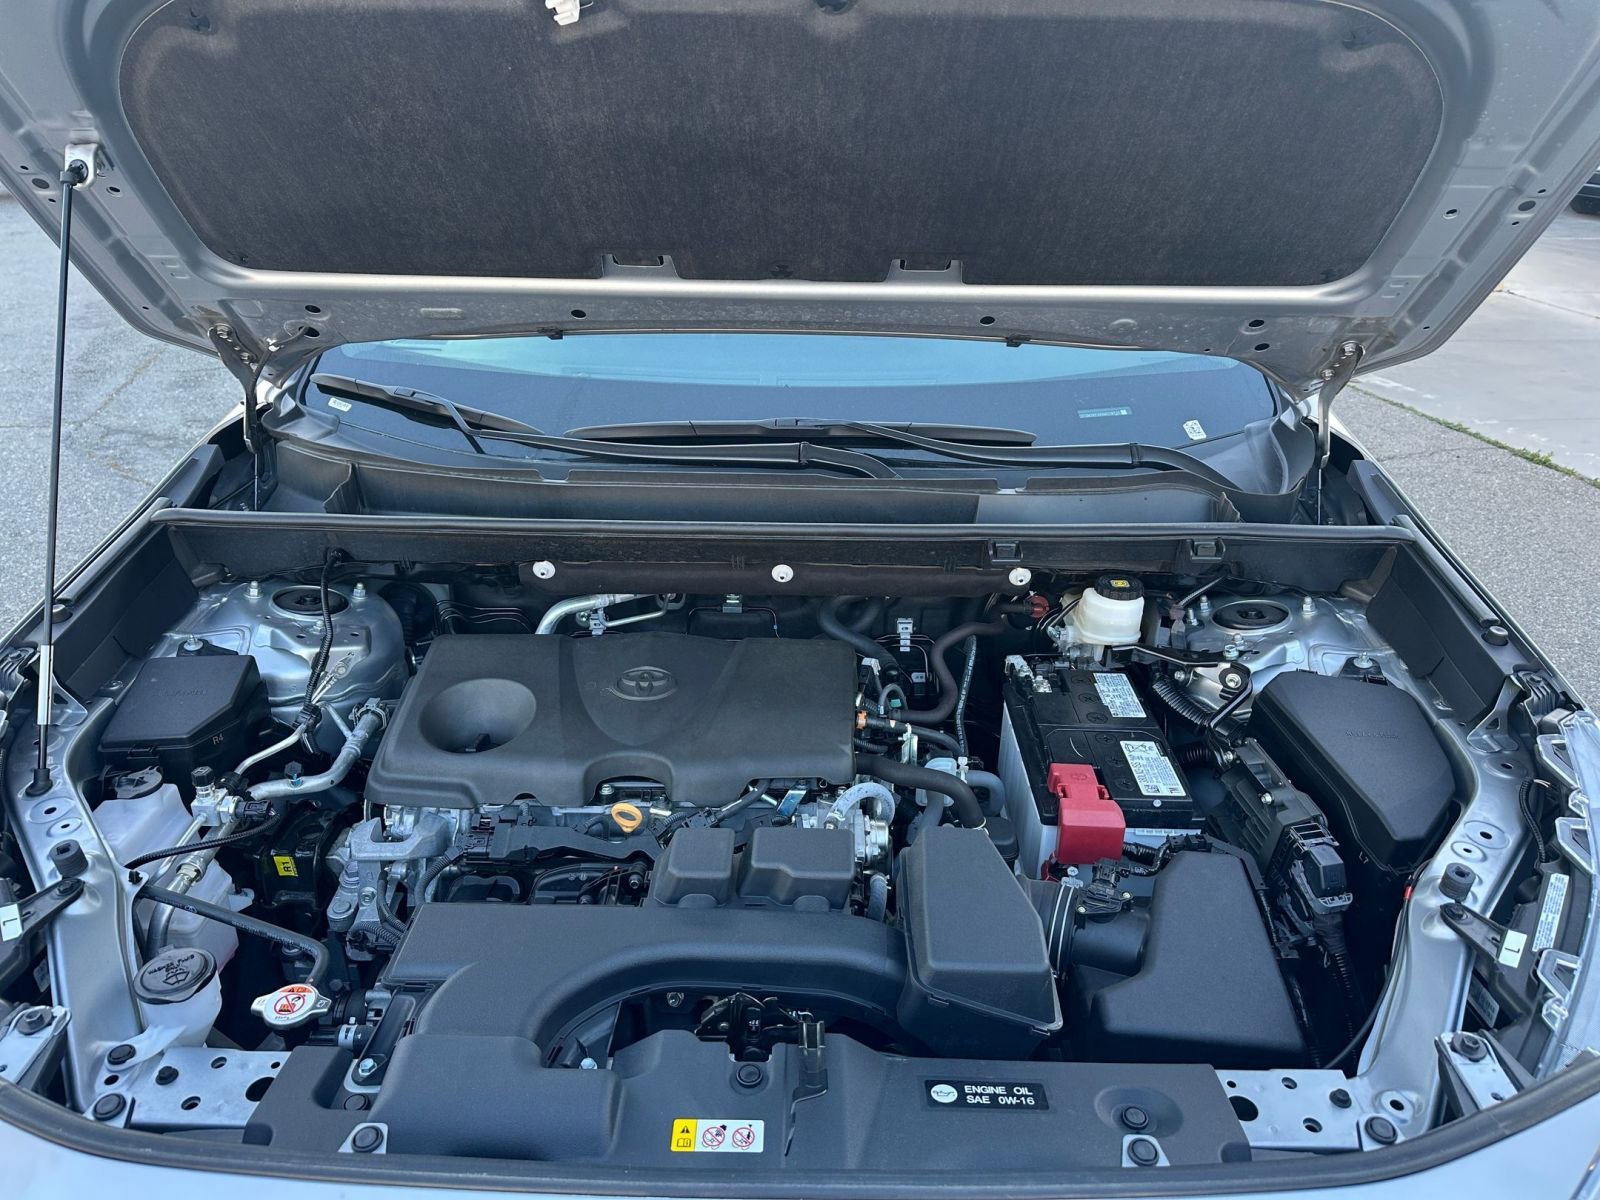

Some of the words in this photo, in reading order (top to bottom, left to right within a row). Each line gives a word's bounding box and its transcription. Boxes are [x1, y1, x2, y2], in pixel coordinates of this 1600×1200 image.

[964, 1085, 1007, 1095] ENGINE
[1013, 1086, 1033, 1095] OIL
[966, 1095, 991, 1104] SAE
[998, 1096, 1035, 1105] 0W-16
